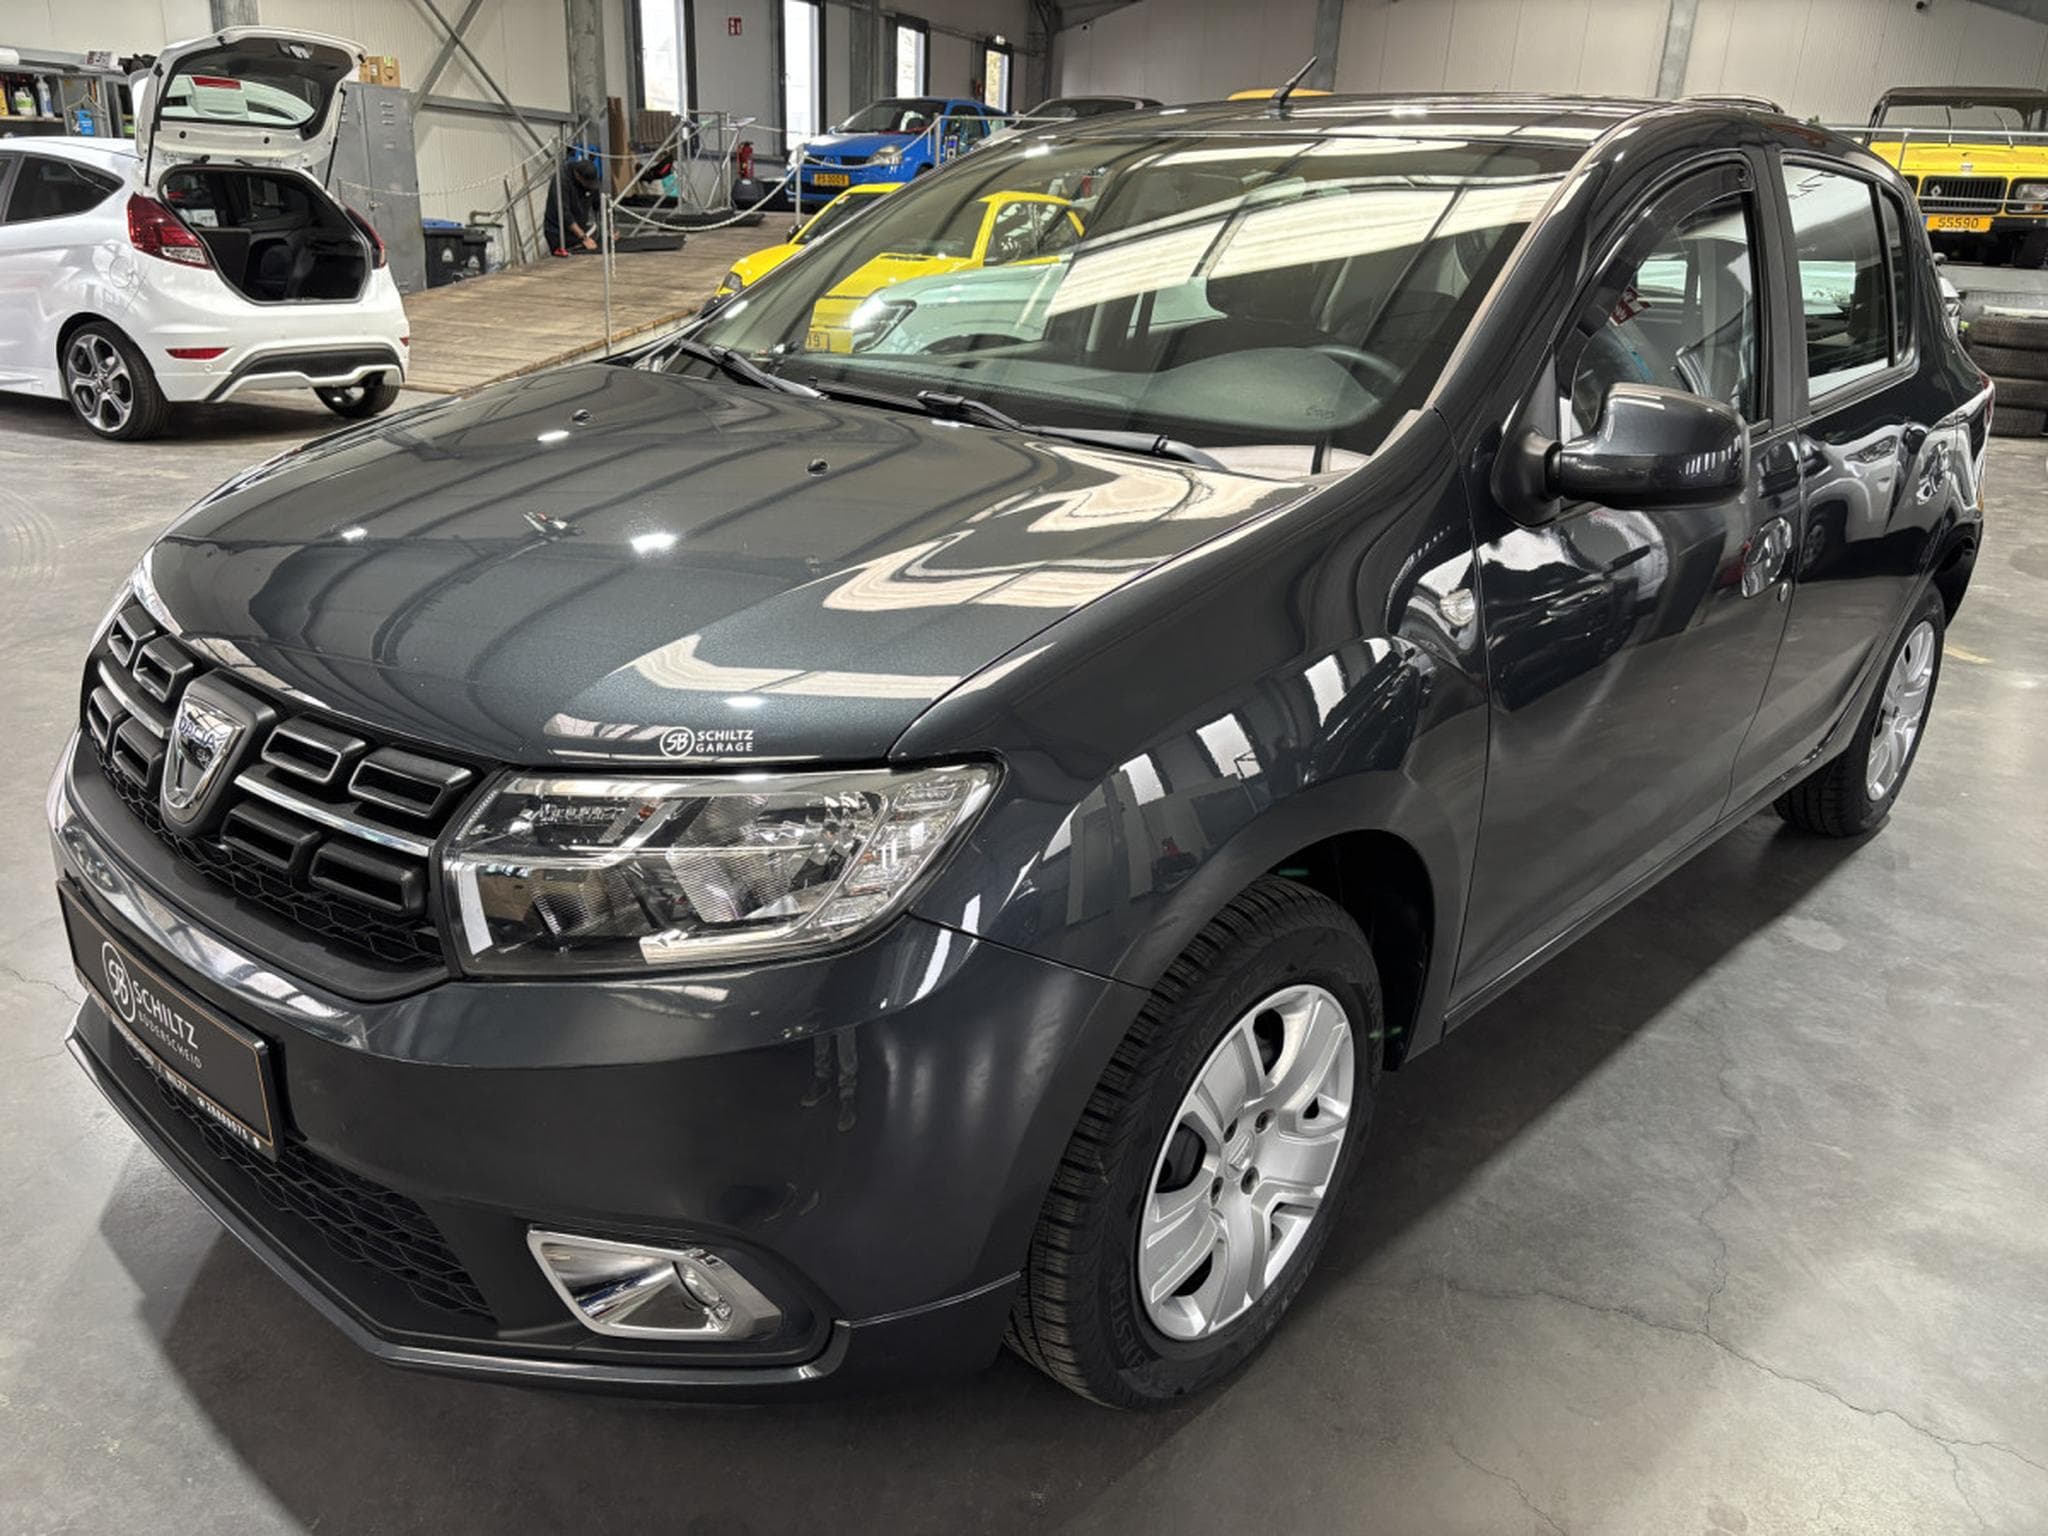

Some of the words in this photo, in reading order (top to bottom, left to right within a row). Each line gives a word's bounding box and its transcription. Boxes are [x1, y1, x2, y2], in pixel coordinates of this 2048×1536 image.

[697, 729, 755, 743] SCHILTZ
[696, 742, 754, 754] GARAGE
[132, 980, 199, 1050] SCHILTZ
